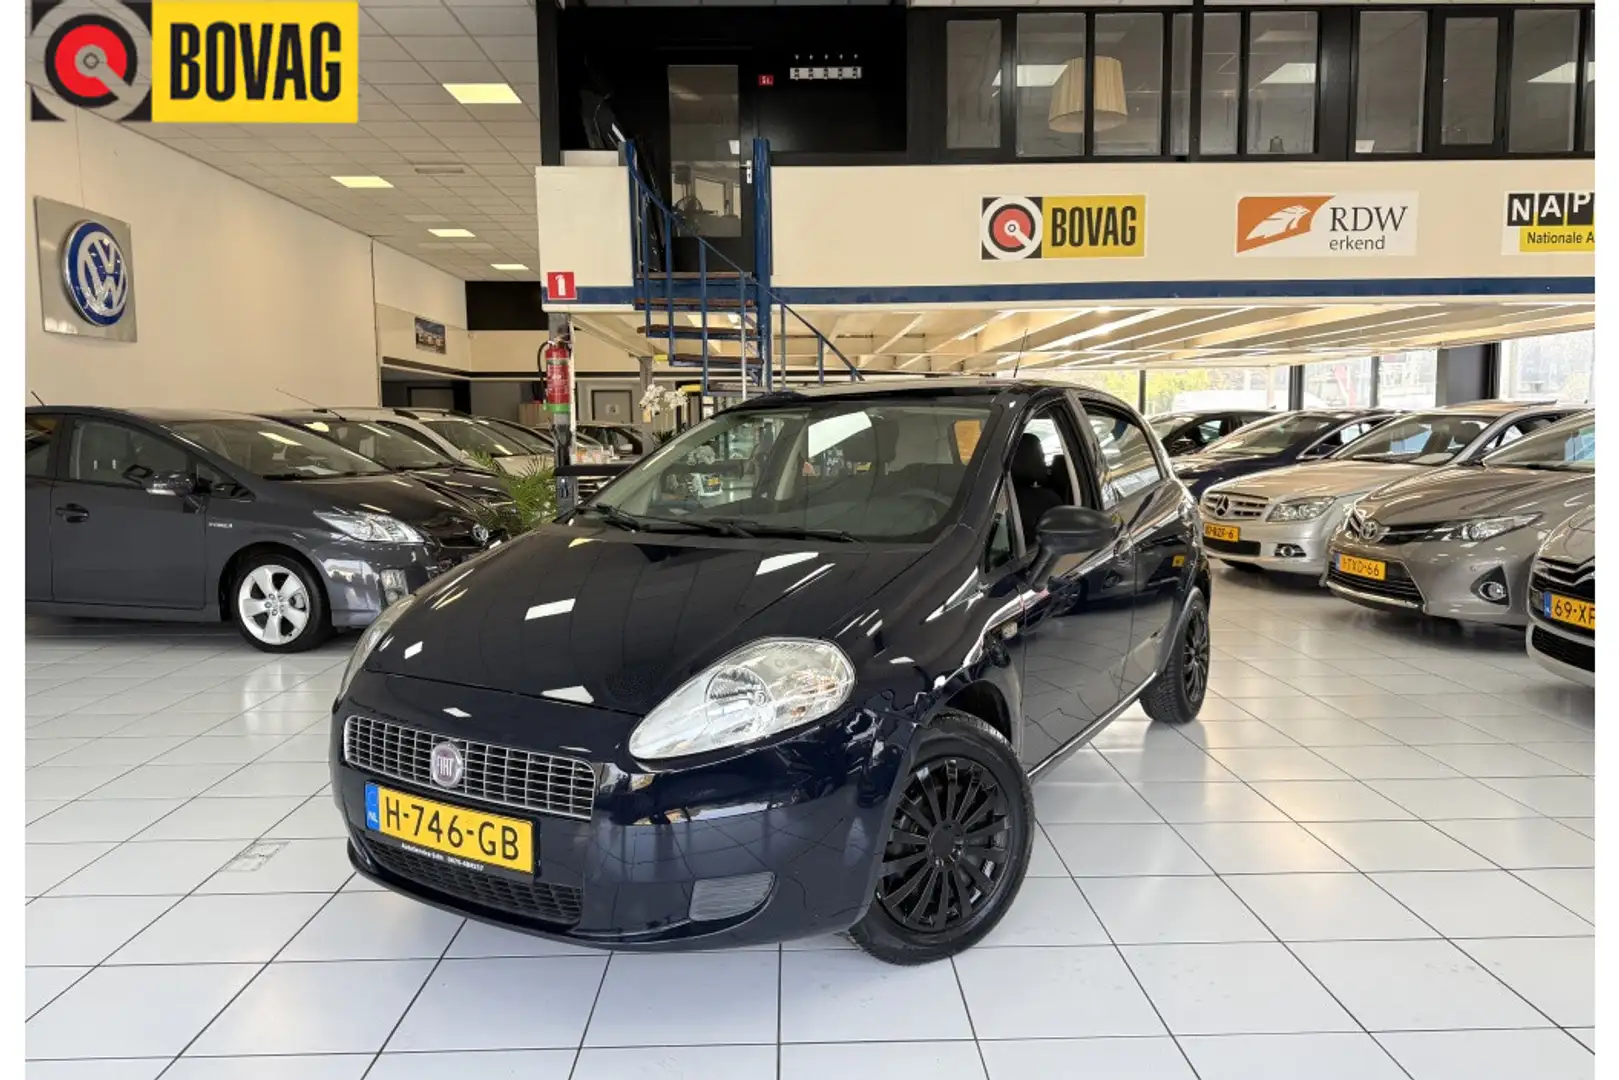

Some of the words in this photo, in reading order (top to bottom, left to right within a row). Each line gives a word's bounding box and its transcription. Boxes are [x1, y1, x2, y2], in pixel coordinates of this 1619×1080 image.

[1329, 206, 1408, 232] RDW
[1511, 192, 1591, 221] NAP
[1051, 206, 1137, 247] BOVAG
[1527, 231, 1583, 244] Nationale
[1329, 235, 1386, 251] erkend
[434, 755, 454, 777] FIAT
[386, 796, 519, 861] H-746-GB
